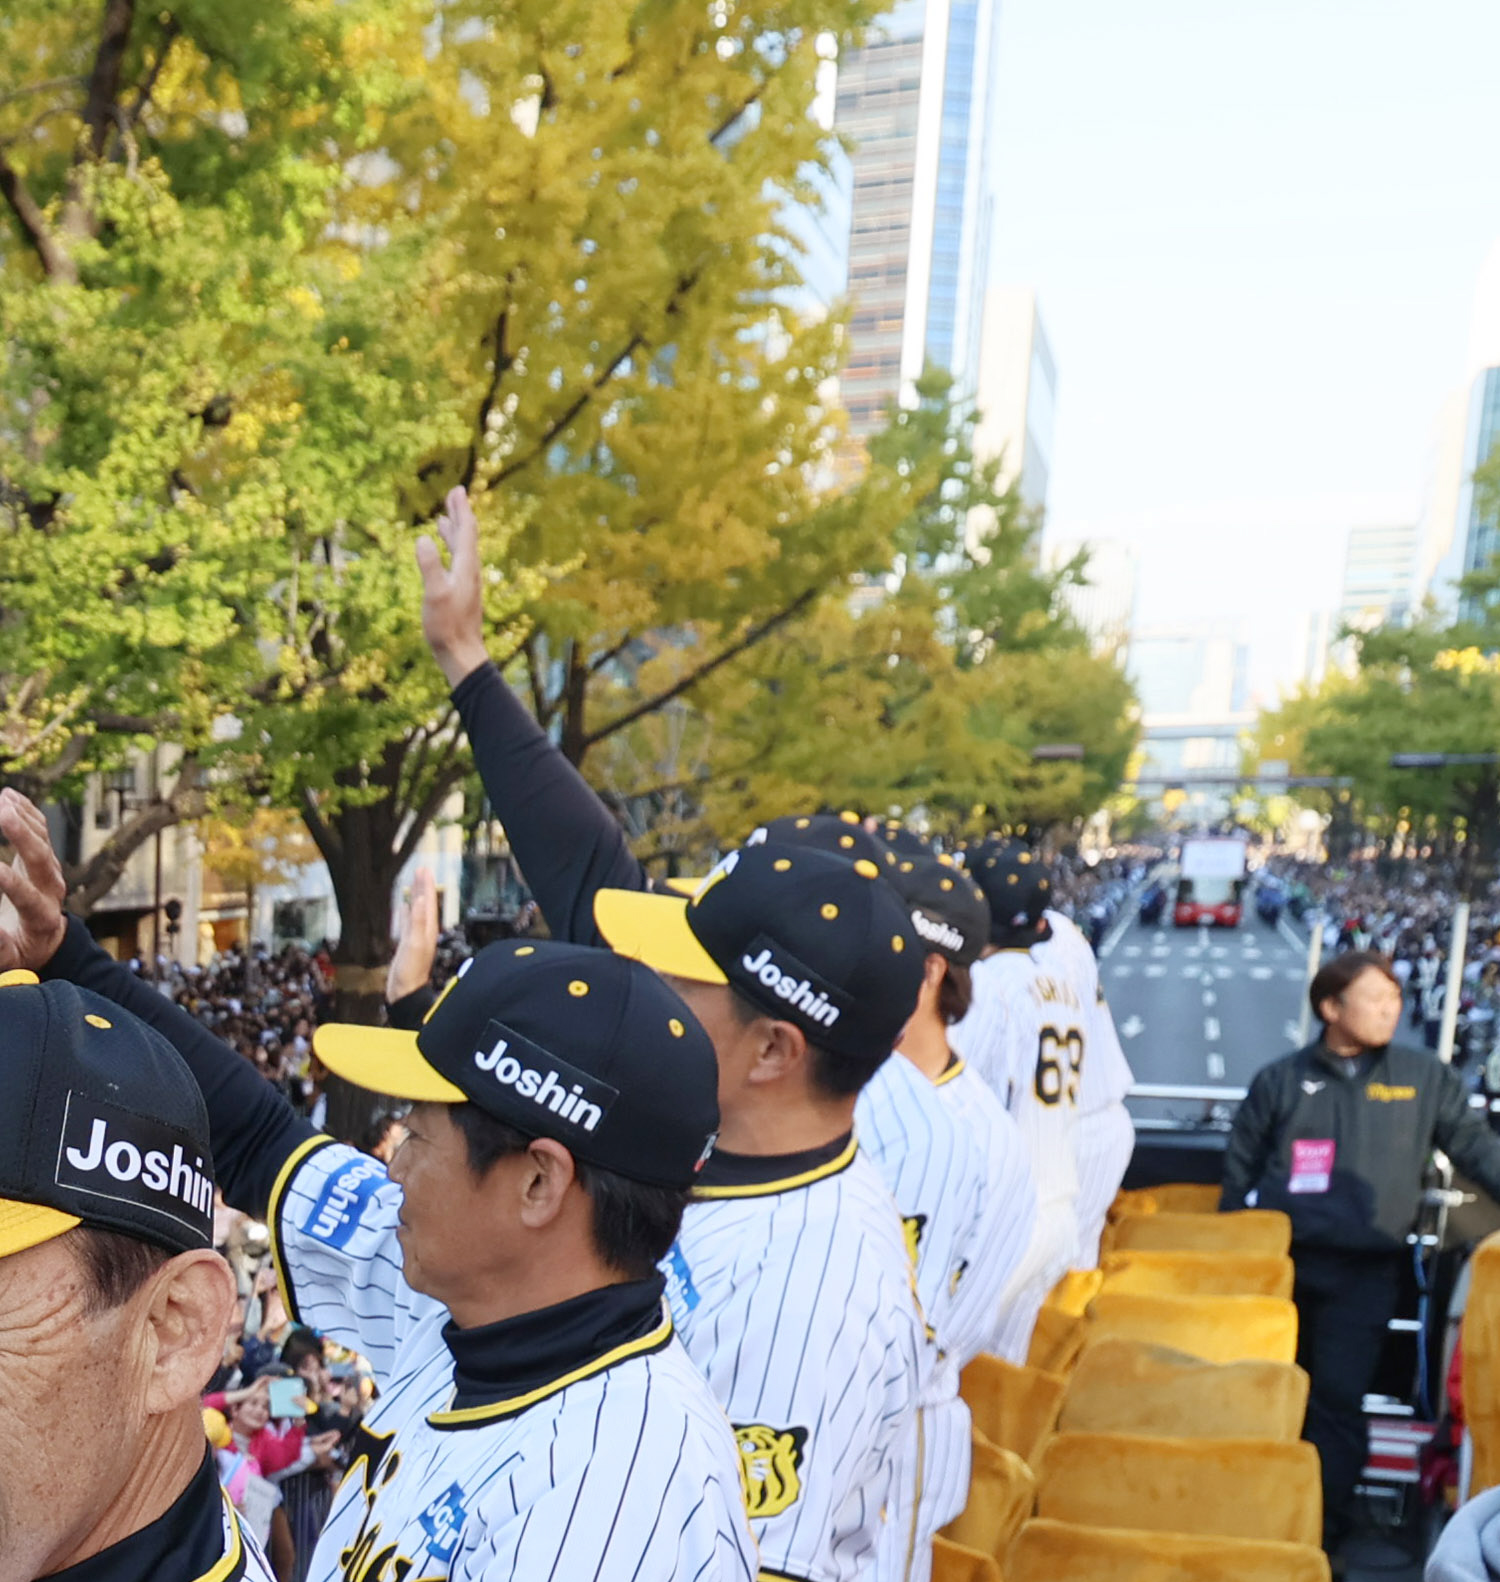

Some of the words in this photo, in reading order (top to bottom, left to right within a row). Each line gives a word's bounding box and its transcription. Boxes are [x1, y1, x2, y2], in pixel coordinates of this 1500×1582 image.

[742, 949, 841, 1028] Joshin
[474, 1039, 602, 1132] Joshin
[65, 1117, 214, 1220] Joshin
